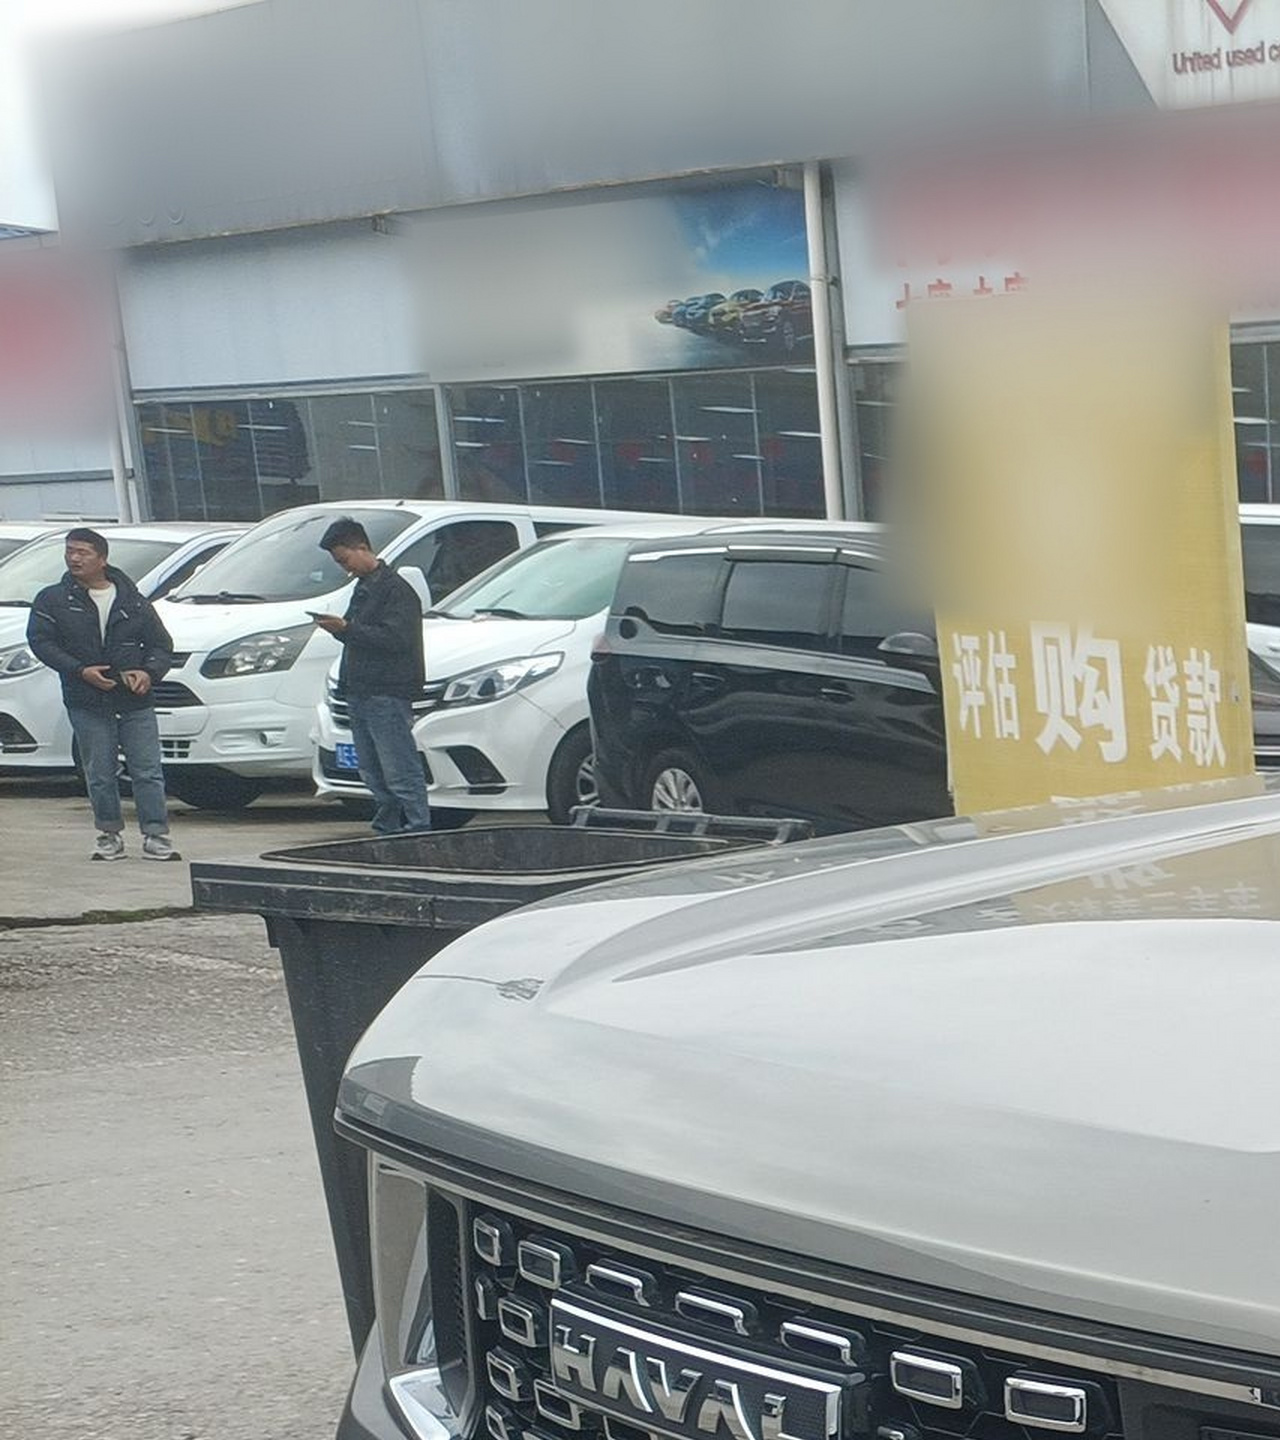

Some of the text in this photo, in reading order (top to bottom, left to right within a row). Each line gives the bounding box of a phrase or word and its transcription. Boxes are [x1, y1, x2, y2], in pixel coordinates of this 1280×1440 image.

[1172, 48, 1222, 75] United
[1226, 42, 1266, 68] used
[952, 620, 1227, 768] 评估 购 贷款
